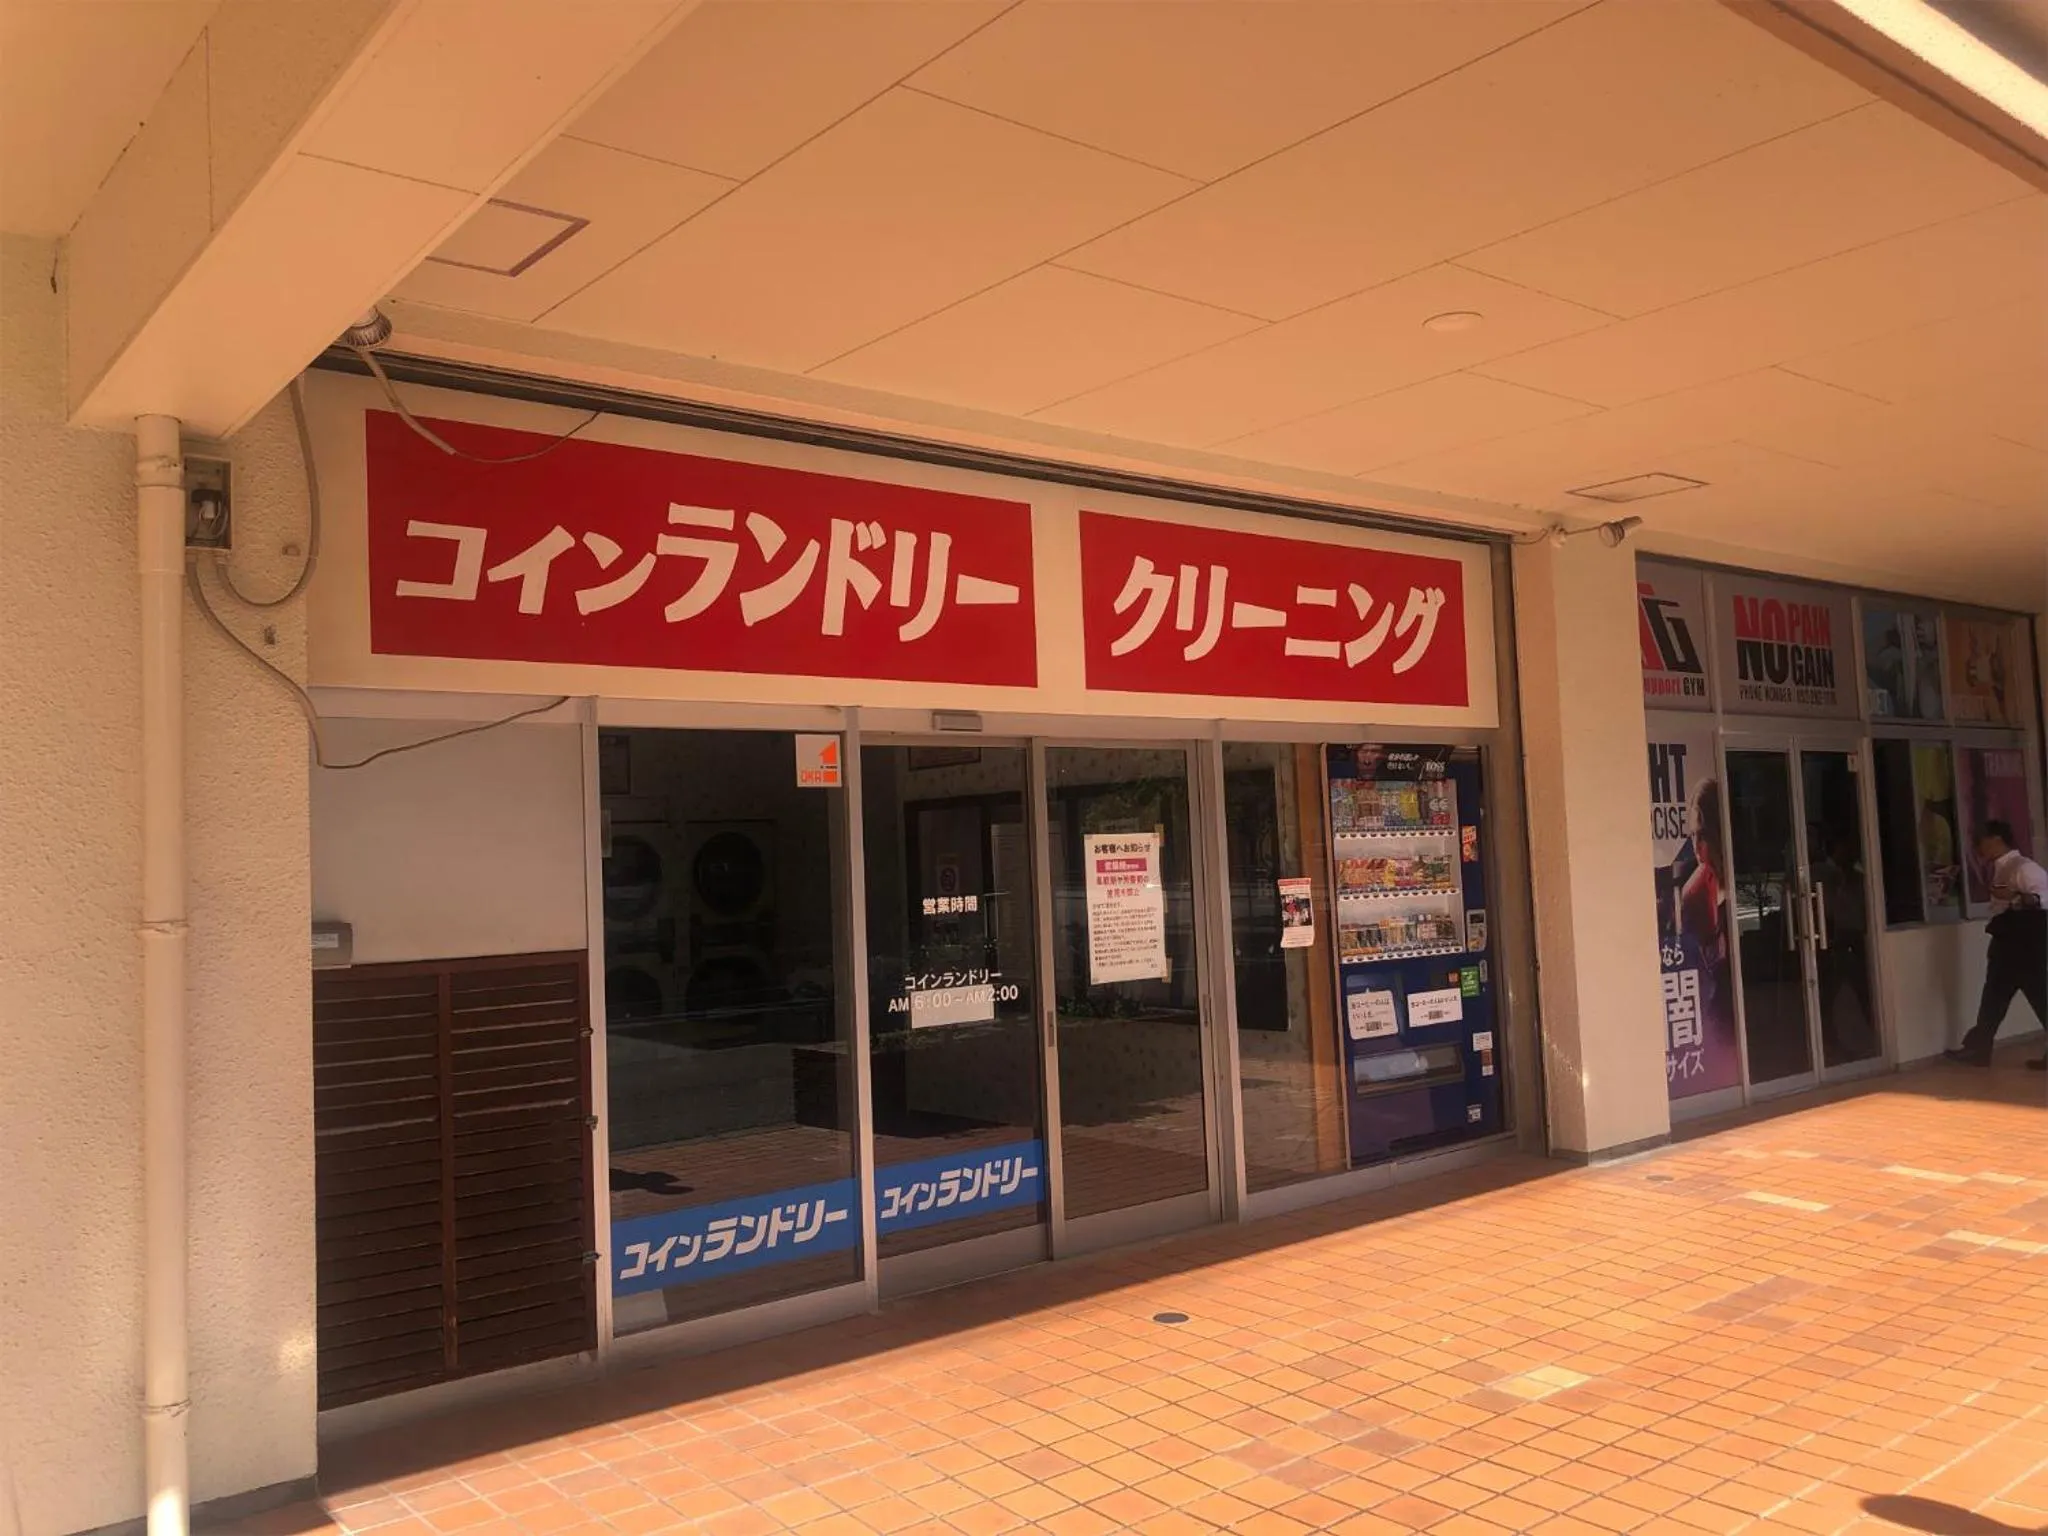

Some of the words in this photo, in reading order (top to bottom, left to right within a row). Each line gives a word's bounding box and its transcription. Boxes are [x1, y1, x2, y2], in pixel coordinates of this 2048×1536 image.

[396, 502, 1020, 642] コインランドリー
[1111, 555, 1445, 674] クリーニング
[1734, 595, 1787, 642] NO
[1787, 602, 1832, 647] PAIN
[1643, 677, 1681, 696] upport
[1682, 676, 1706, 697] GYM
[1737, 639, 1789, 685] NO
[1790, 644, 1835, 689] GAIN
[1647, 743, 1687, 804] HT
[1651, 806, 1688, 841] CISE
[922, 895, 978, 916] 営業時間
[904, 967, 1003, 991] コインランドリー
[1661, 944, 1685, 967] なら
[1660, 969, 1704, 1049] 闇
[1666, 1047, 1705, 1083] サイズ
[881, 1156, 1038, 1221] コインランドリー
[619, 1199, 848, 1281] コインランドリー
